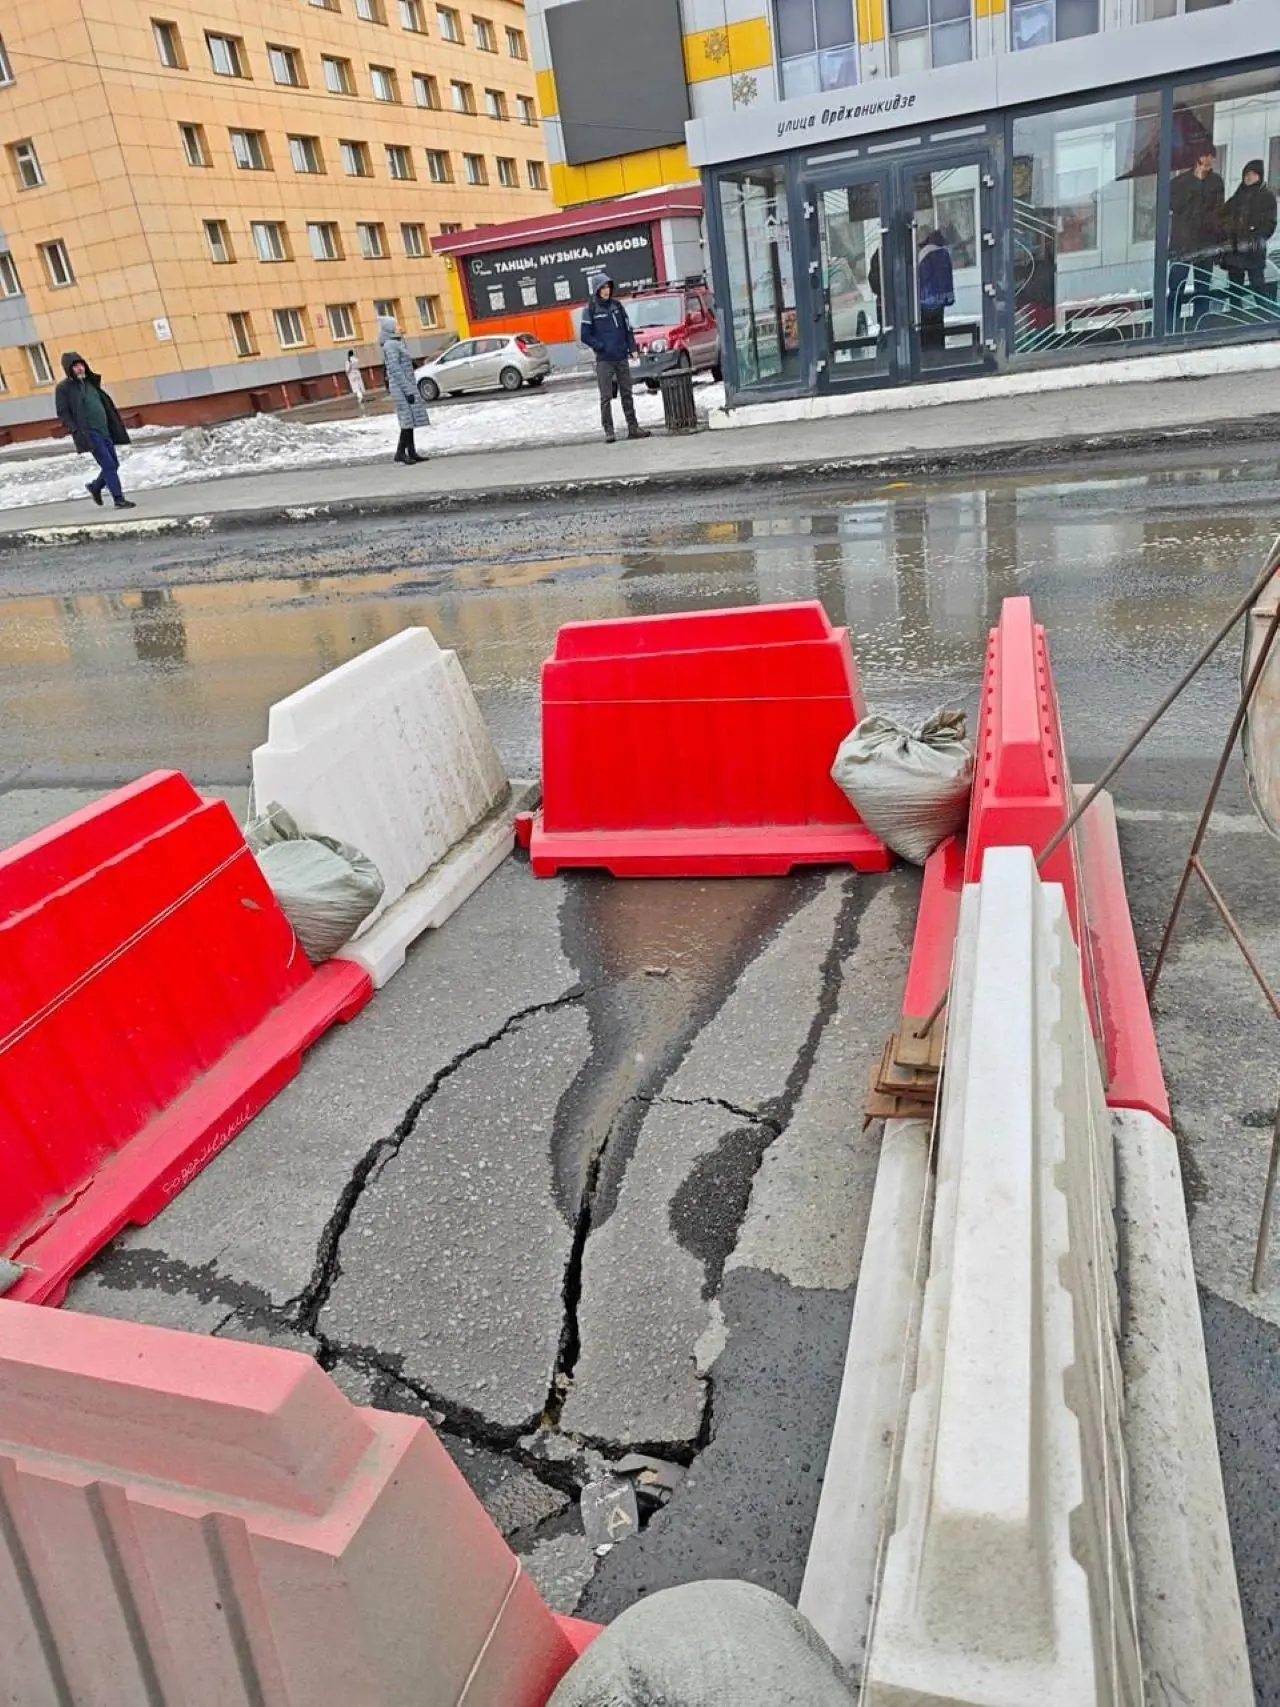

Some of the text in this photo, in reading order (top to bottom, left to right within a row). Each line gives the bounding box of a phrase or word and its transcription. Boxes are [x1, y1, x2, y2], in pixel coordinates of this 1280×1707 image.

[777, 94, 916, 137] улица Орджоникидзе
[494, 236, 648, 273] ТАНЦЫ, МУЗЫКА, ЛЮБОВЬ
